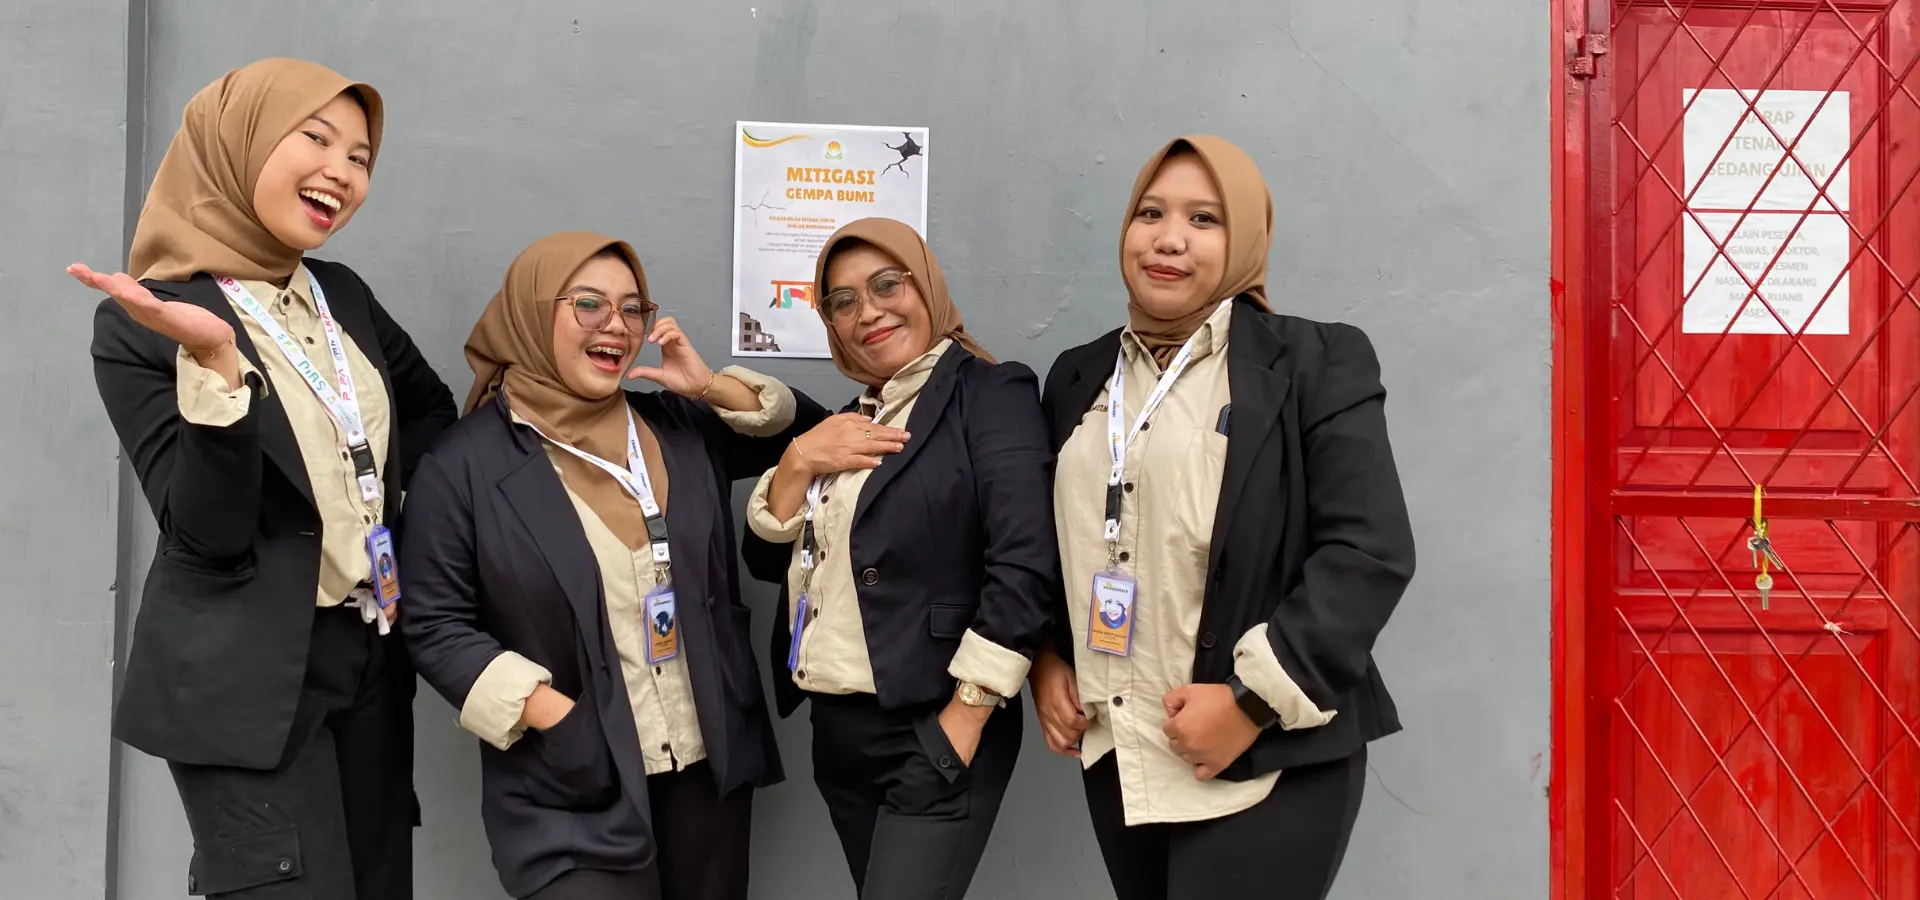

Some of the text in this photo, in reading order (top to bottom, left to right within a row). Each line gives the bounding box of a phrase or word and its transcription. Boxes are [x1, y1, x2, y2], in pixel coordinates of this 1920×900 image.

[787, 167, 875, 185] MITIGASI
[786, 188, 875, 202] GEMPA BUMI
[1726, 230, 1806, 241] LAIN PESEA,
[1772, 247, 1820, 256] POKTOR,
[1767, 278, 1817, 287] DILARANG
[1768, 293, 1803, 302] RUANG
